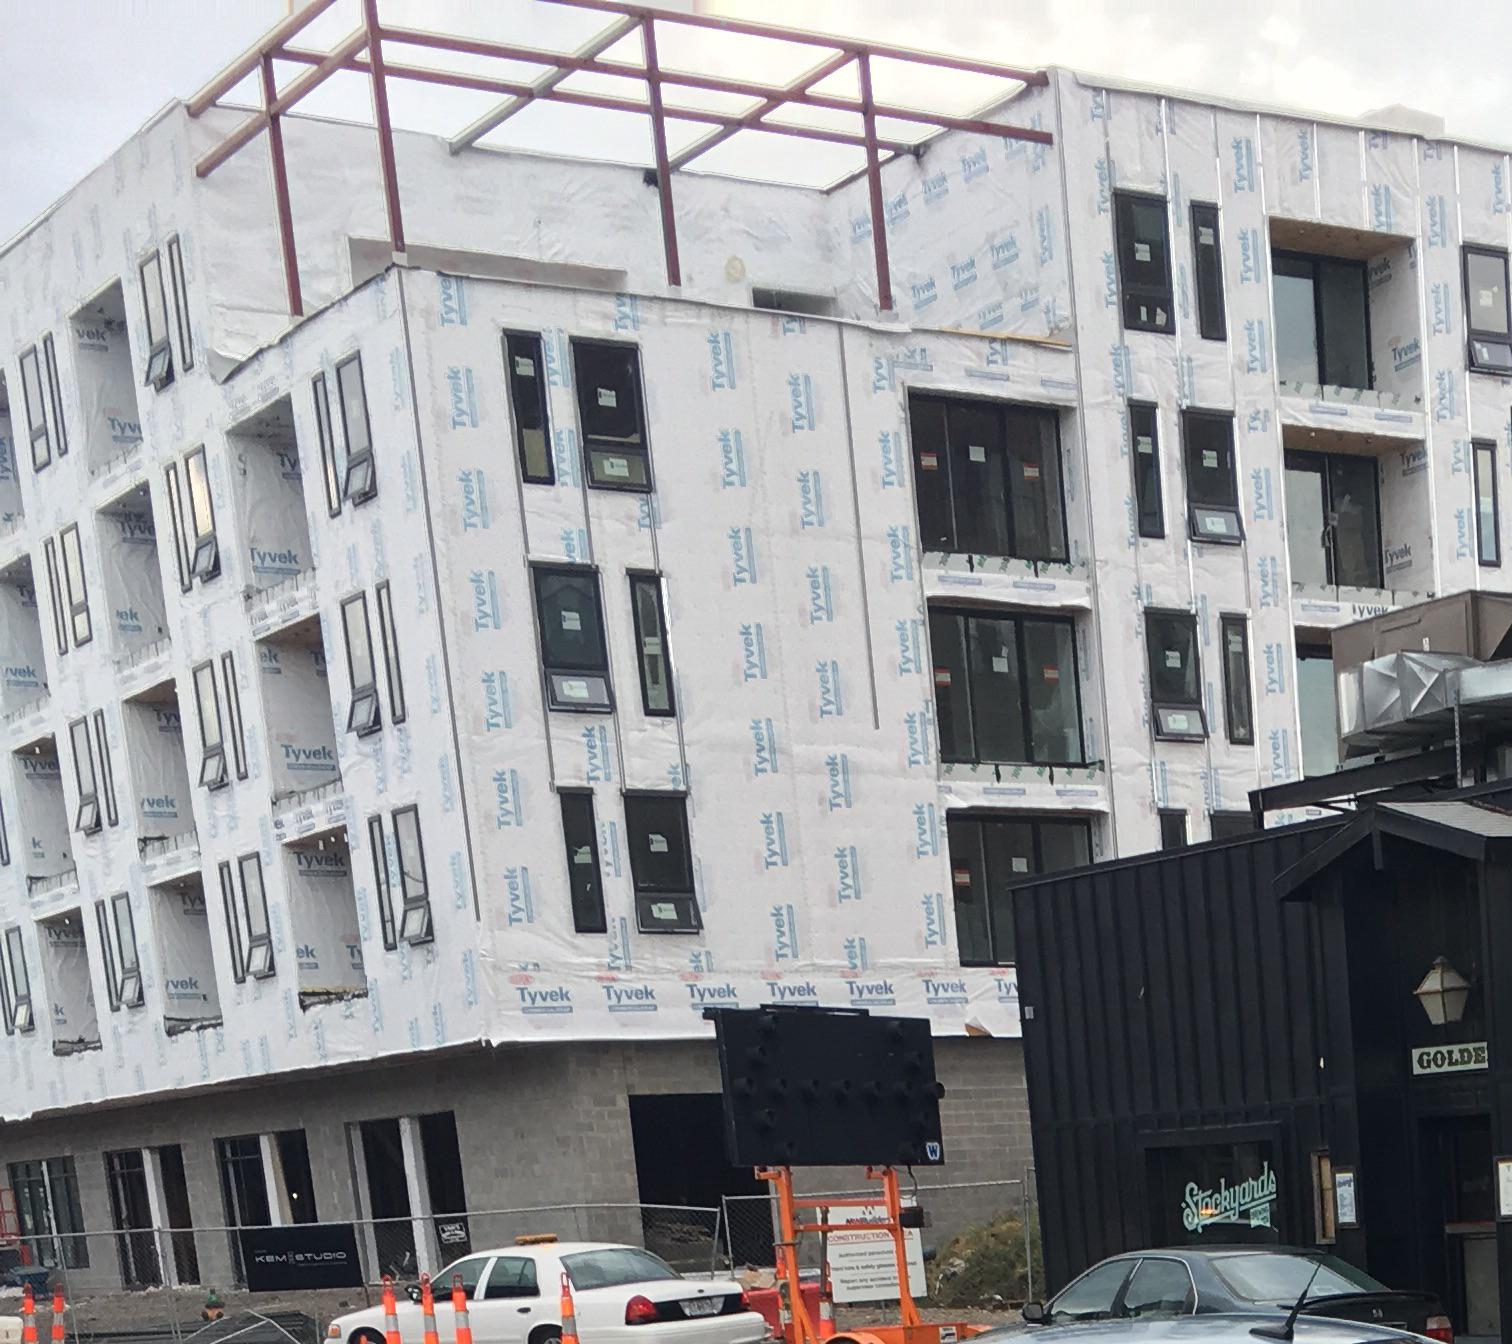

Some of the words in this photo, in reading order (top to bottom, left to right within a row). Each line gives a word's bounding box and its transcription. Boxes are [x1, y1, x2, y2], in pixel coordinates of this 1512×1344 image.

[1232, 138, 1246, 193] Tyvek
[1299, 128, 1313, 182] Tyvek
[1371, 184, 1385, 229] yvek
[1492, 161, 1506, 214] Tyvek
[991, 232, 1017, 259] Tyvek
[1425, 196, 1440, 248] Tyvek
[951, 256, 976, 281] Tyvek
[1238, 228, 1251, 284] Tyvek
[439, 275, 458, 327] Tyve
[614, 295, 632, 331] Tyv
[911, 274, 936, 300] Tyvek
[1432, 282, 1442, 336] Tyvek
[76, 327, 106, 341] vek
[1244, 320, 1258, 374] Tyvek
[1391, 338, 1420, 361] Tyvek
[707, 331, 725, 391] Tyvek
[872, 357, 885, 393] Tyv
[448, 366, 467, 430] Tyvek
[788, 373, 805, 432] Tyvek
[1436, 368, 1448, 422] Tyvek
[108, 416, 142, 434] Tyv
[717, 430, 735, 489] Tyvek
[878, 431, 895, 489] Tyvek
[1452, 440, 1463, 474] Tyv
[458, 468, 478, 530] Tyvek
[637, 494, 652, 531] Tyv
[797, 470, 815, 529] Tyvek
[1251, 468, 1266, 521] Tyvek
[250, 548, 299, 565] Tyvek
[561, 528, 577, 562] vek
[727, 527, 747, 587] Tyvek
[887, 526, 903, 583] Tyvek
[1456, 508, 1467, 560] Tyvek
[470, 570, 492, 632] Tyvek
[806, 566, 823, 624] Tyvek
[1260, 556, 1273, 609] Tyvek
[5, 665, 36, 680] vek
[740, 624, 757, 682] Tyvek
[896, 620, 912, 676] Tyvek
[1265, 643, 1279, 696] Tyvek
[482, 671, 503, 731] Tyvek
[816, 660, 833, 718] Tyvek
[154, 708, 180, 724] Tyv
[904, 712, 921, 768] Tyvek
[19, 757, 58, 773] Tyve
[281, 744, 334, 762] Tyvek
[582, 725, 602, 784] Tyvek
[751, 719, 768, 776] Tyvek
[1272, 729, 1284, 781] Tyvek
[142, 795, 176, 809] vek
[493, 769, 512, 829] Tyvek
[825, 754, 842, 811] Tyvek
[760, 812, 778, 870] Tyvek
[913, 803, 929, 859] Tyvek
[294, 851, 343, 868] Tyvek
[834, 847, 852, 904] Tyvek
[504, 867, 523, 926] Tyvek
[922, 894, 939, 949] Tyvek
[770, 905, 788, 962] Tyvek
[844, 937, 859, 970] vek
[167, 977, 198, 990] vek
[516, 987, 571, 1005] Tyvek
[602, 985, 656, 1003] Tyvek
[686, 984, 737, 1001] Tyvek
[767, 982, 817, 999] Tyvek
[847, 980, 894, 998] Tyvek
[923, 979, 966, 996] Tyvek
[995, 978, 1017, 995] Tyv
[1417, 1046, 1487, 1070] GOLDE
[1181, 1160, 1277, 1233] Stockyards
[827, 1231, 890, 1242] CONSTRUCTION
